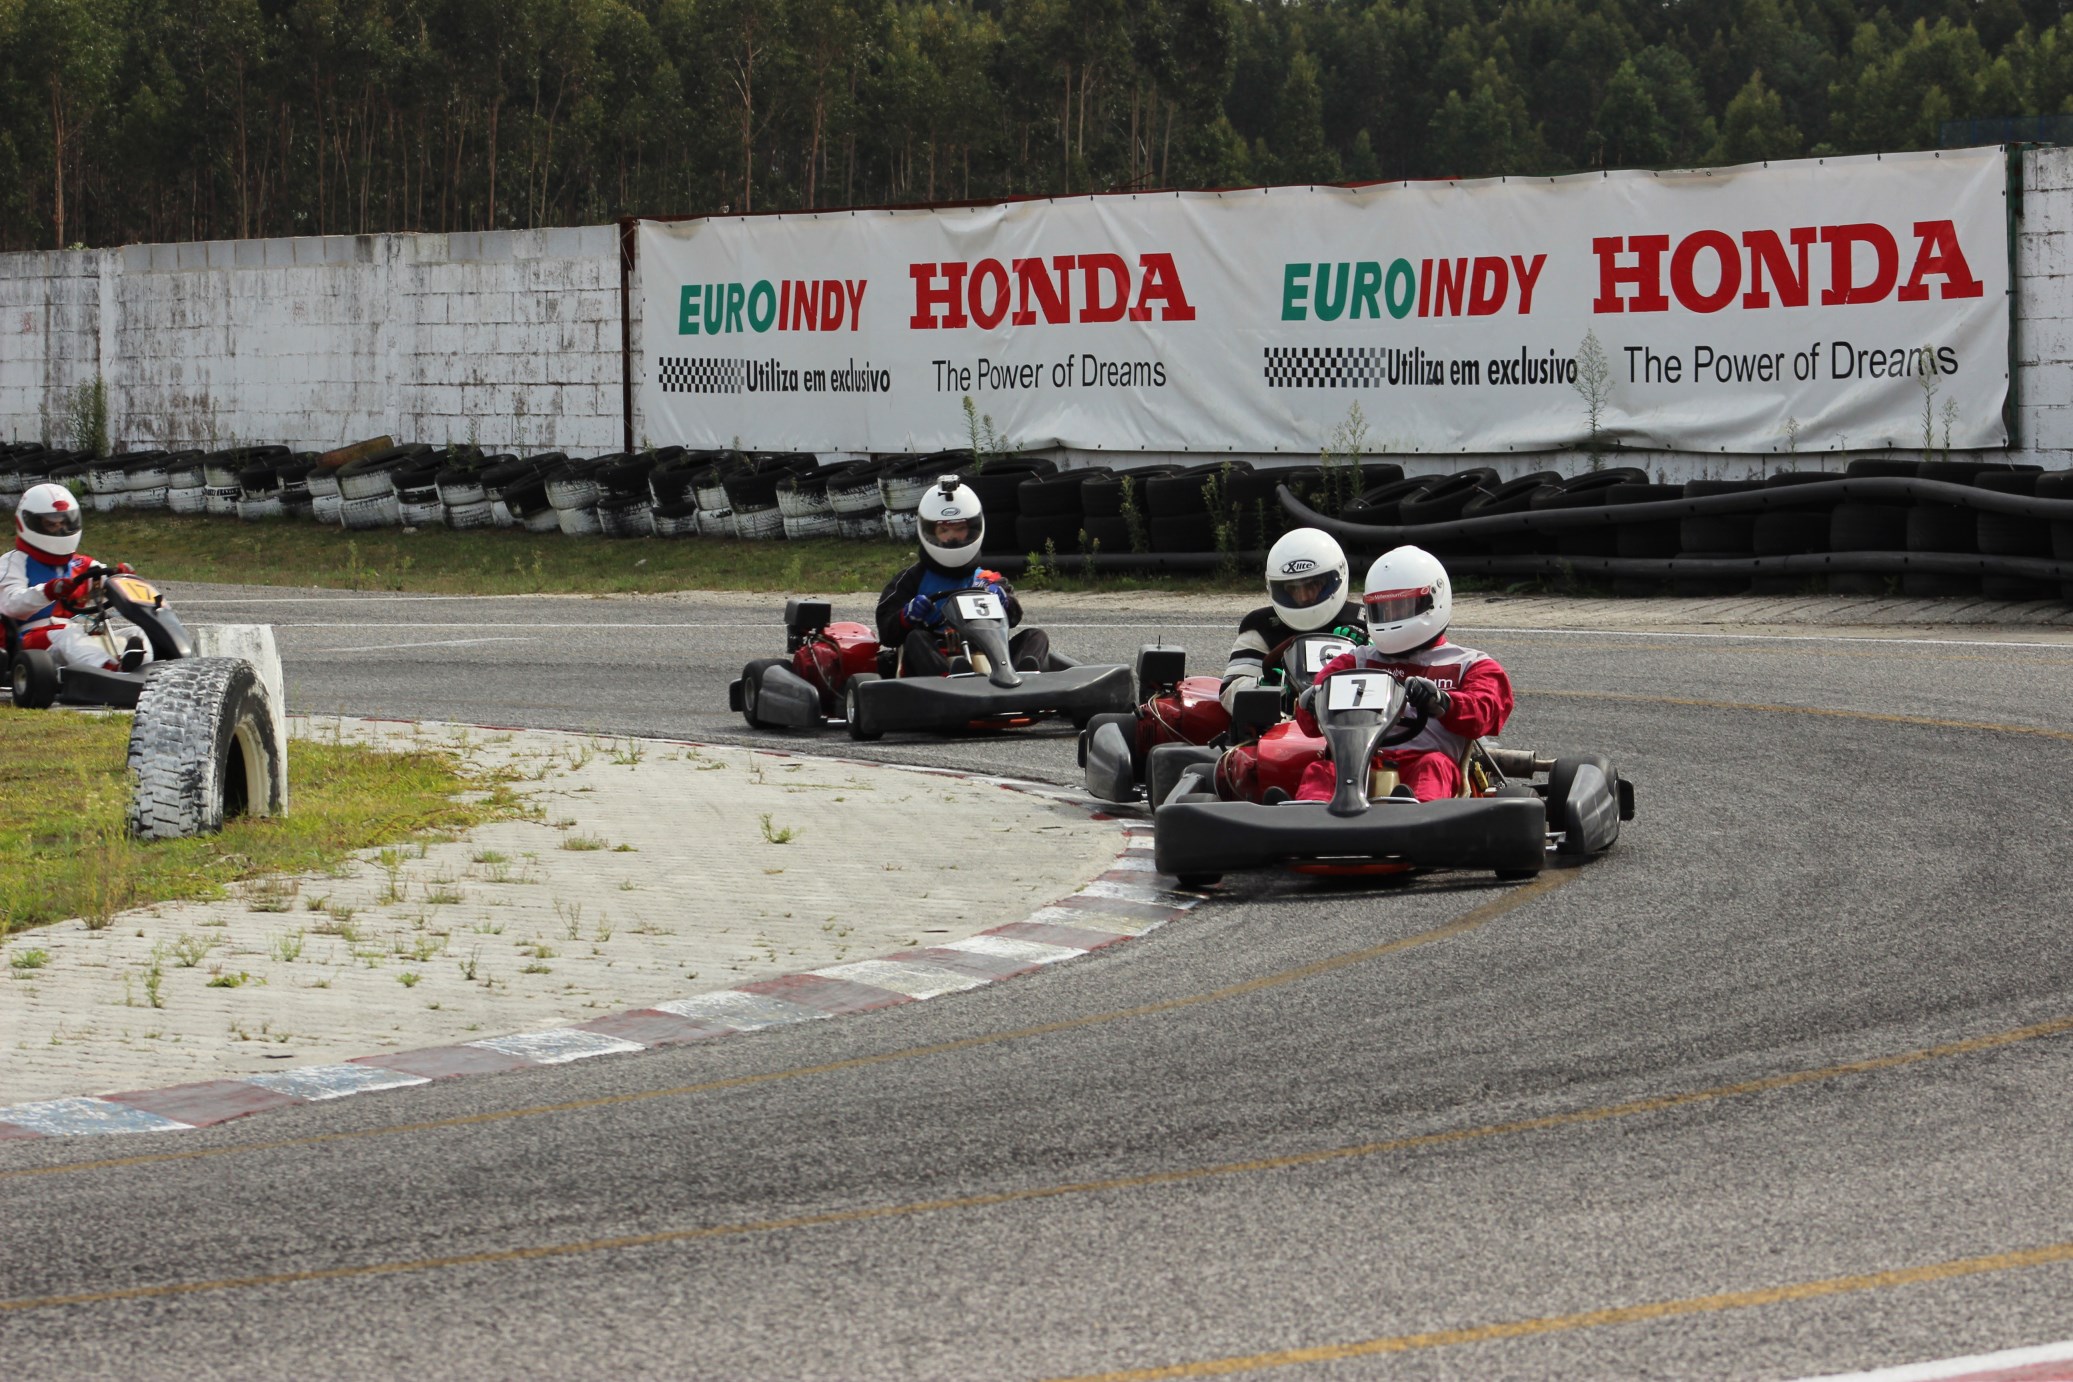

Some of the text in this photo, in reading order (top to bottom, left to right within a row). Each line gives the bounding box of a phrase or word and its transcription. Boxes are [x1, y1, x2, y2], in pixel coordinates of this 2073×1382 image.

[1281, 254, 1548, 321] EUROINDY
[1592, 219, 1984, 314] HONDA
[678, 279, 868, 336] EUROINDY
[909, 253, 1196, 330] HONDA
[746, 357, 891, 393] Utiliza em exclusivo
[932, 353, 1167, 392] The Power of Dreams
[1387, 345, 1578, 386] Utiliza em exclusivo
[1623, 340, 1959, 384] The Power of Dreams
[972, 598, 990, 617] 5
[1350, 679, 1367, 707] 7
